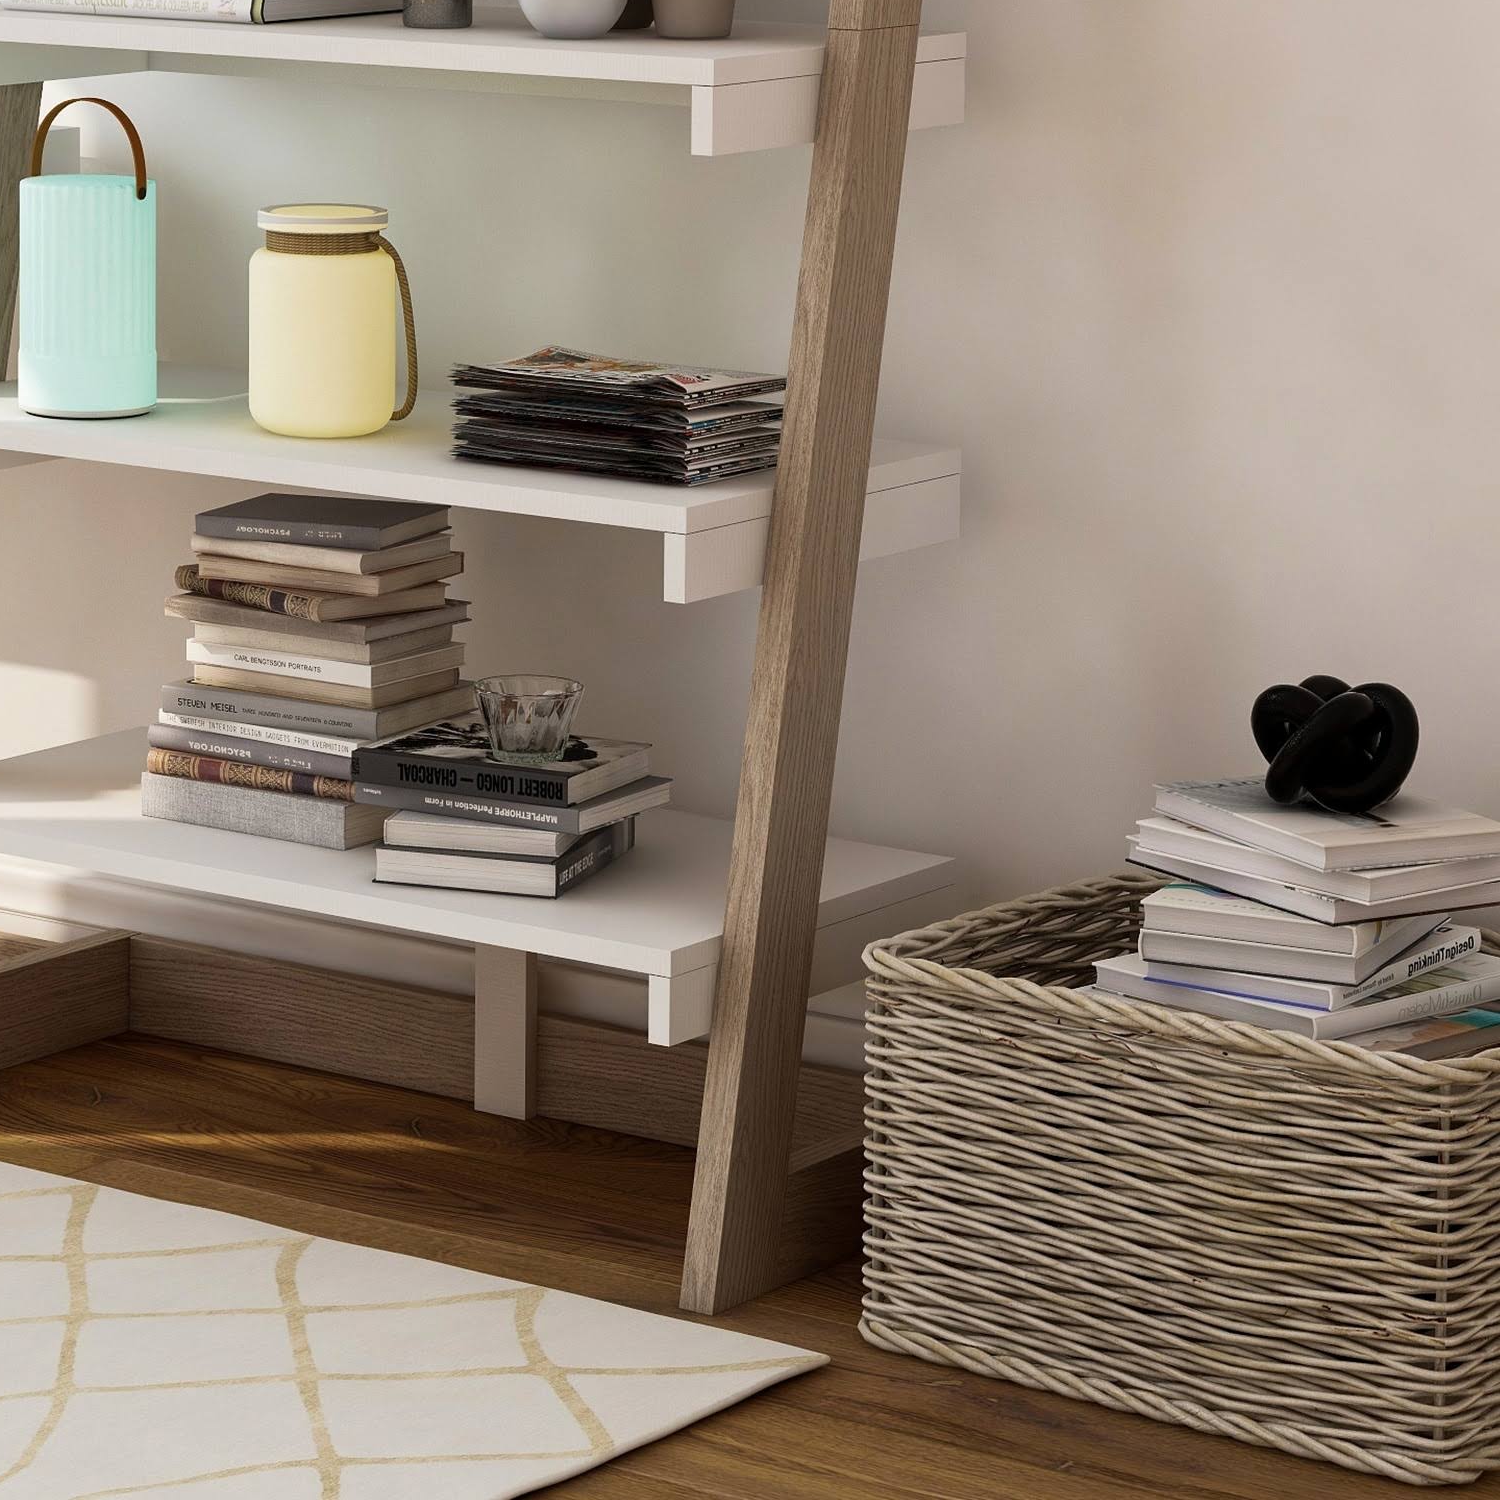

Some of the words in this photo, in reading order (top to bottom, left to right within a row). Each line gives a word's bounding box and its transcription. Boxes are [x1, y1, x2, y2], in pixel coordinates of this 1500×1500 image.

[235, 525, 291, 536] PSYCHOLOGY
[233, 653, 250, 664] CARL
[250, 655, 287, 669] BENGTSSON
[287, 661, 323, 674] PORTRAITS
[177, 697, 207, 710] STEVEN
[210, 701, 238, 714] MEISEL
[282, 712, 294, 720] AND
[208, 721, 237, 734] INTERIOR
[397, 762, 458, 788] CHARCOAL
[476, 772, 514, 796] LONGO
[516, 776, 563, 800] ROBERT
[424, 796, 444, 807] Form
[446, 799, 454, 809] in
[455, 798, 493, 816] Perfection
[494, 806, 558, 825] MAPPLETHORPE
[559, 869, 569, 886] LIFE
[568, 864, 575, 881] AT
[574, 859, 583, 877] THE
[582, 852, 595, 874] EDGE
